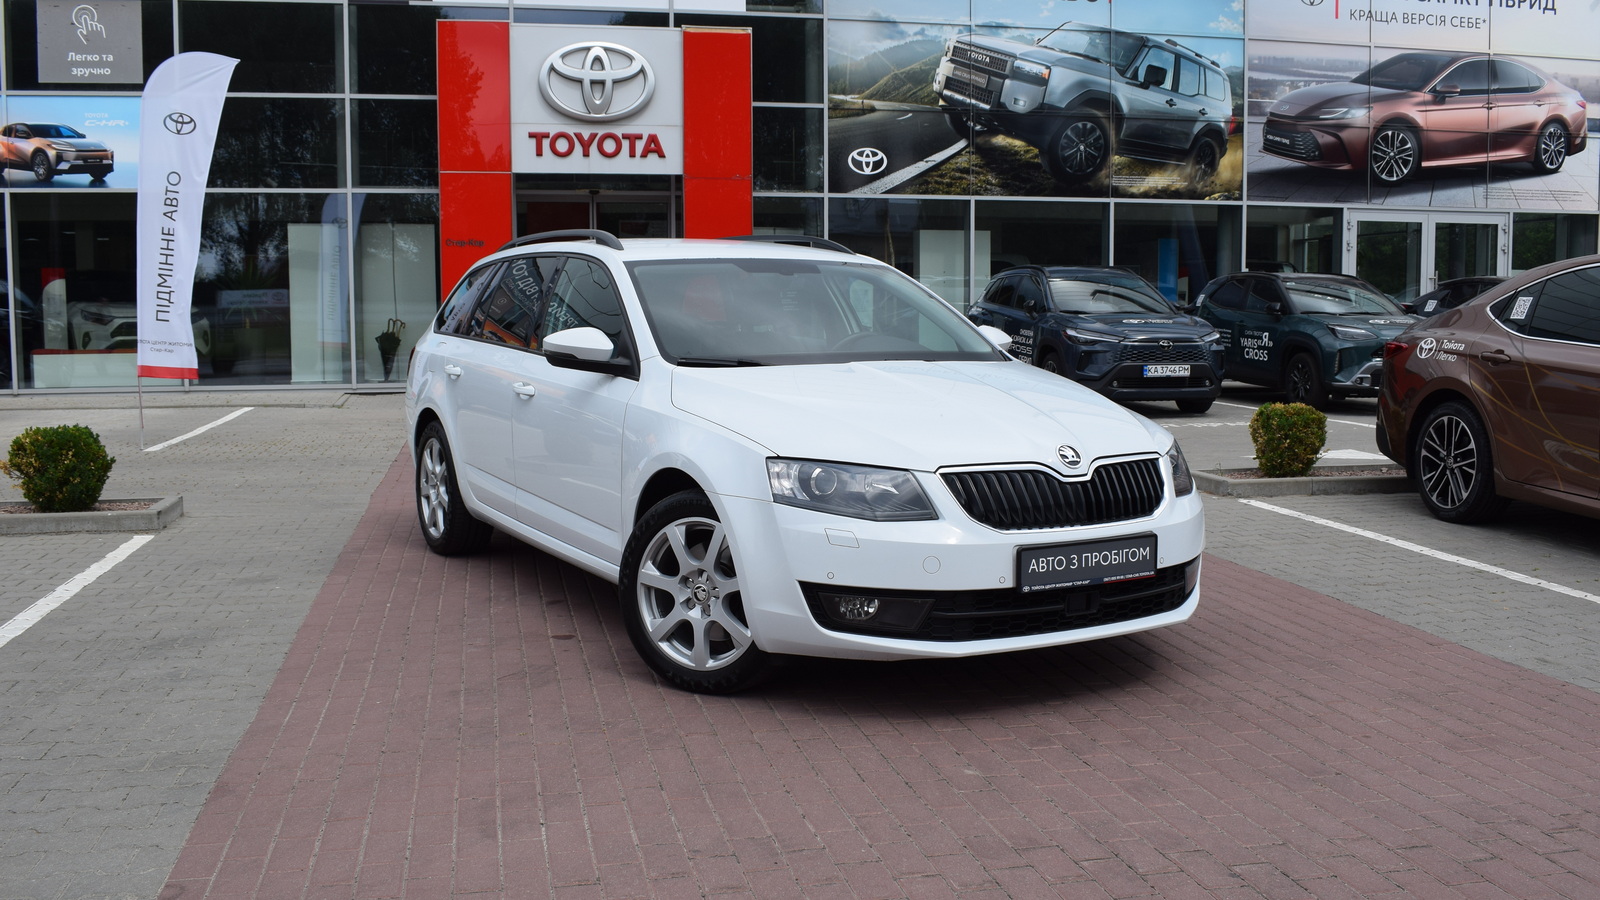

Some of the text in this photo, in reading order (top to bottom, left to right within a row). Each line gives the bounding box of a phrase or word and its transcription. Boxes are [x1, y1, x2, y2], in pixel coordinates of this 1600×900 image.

[1349, 9, 1398, 25] КРАЩА
[1402, 12, 1446, 27] ВЕРСІЯ
[67, 52, 114, 62] Легко та
[967, 51, 990, 63] TOYOTA
[71, 67, 111, 77] зручно
[528, 131, 666, 158] TOYOTA
[155, 171, 182, 322] ПІДМІННЕ АВТО
[446, 239, 485, 247] Стар-Кар
[1240, 337, 1257, 348] YARIS
[1441, 339, 1465, 351] Тойота
[1244, 348, 1268, 361] CROSS
[1436, 351, 1457, 362] Легко
[1147, 366, 1190, 375] KA 3746 PM
[1028, 555, 1067, 573] АВТО
[1082, 546, 1150, 568] ПРОБІГОМ
